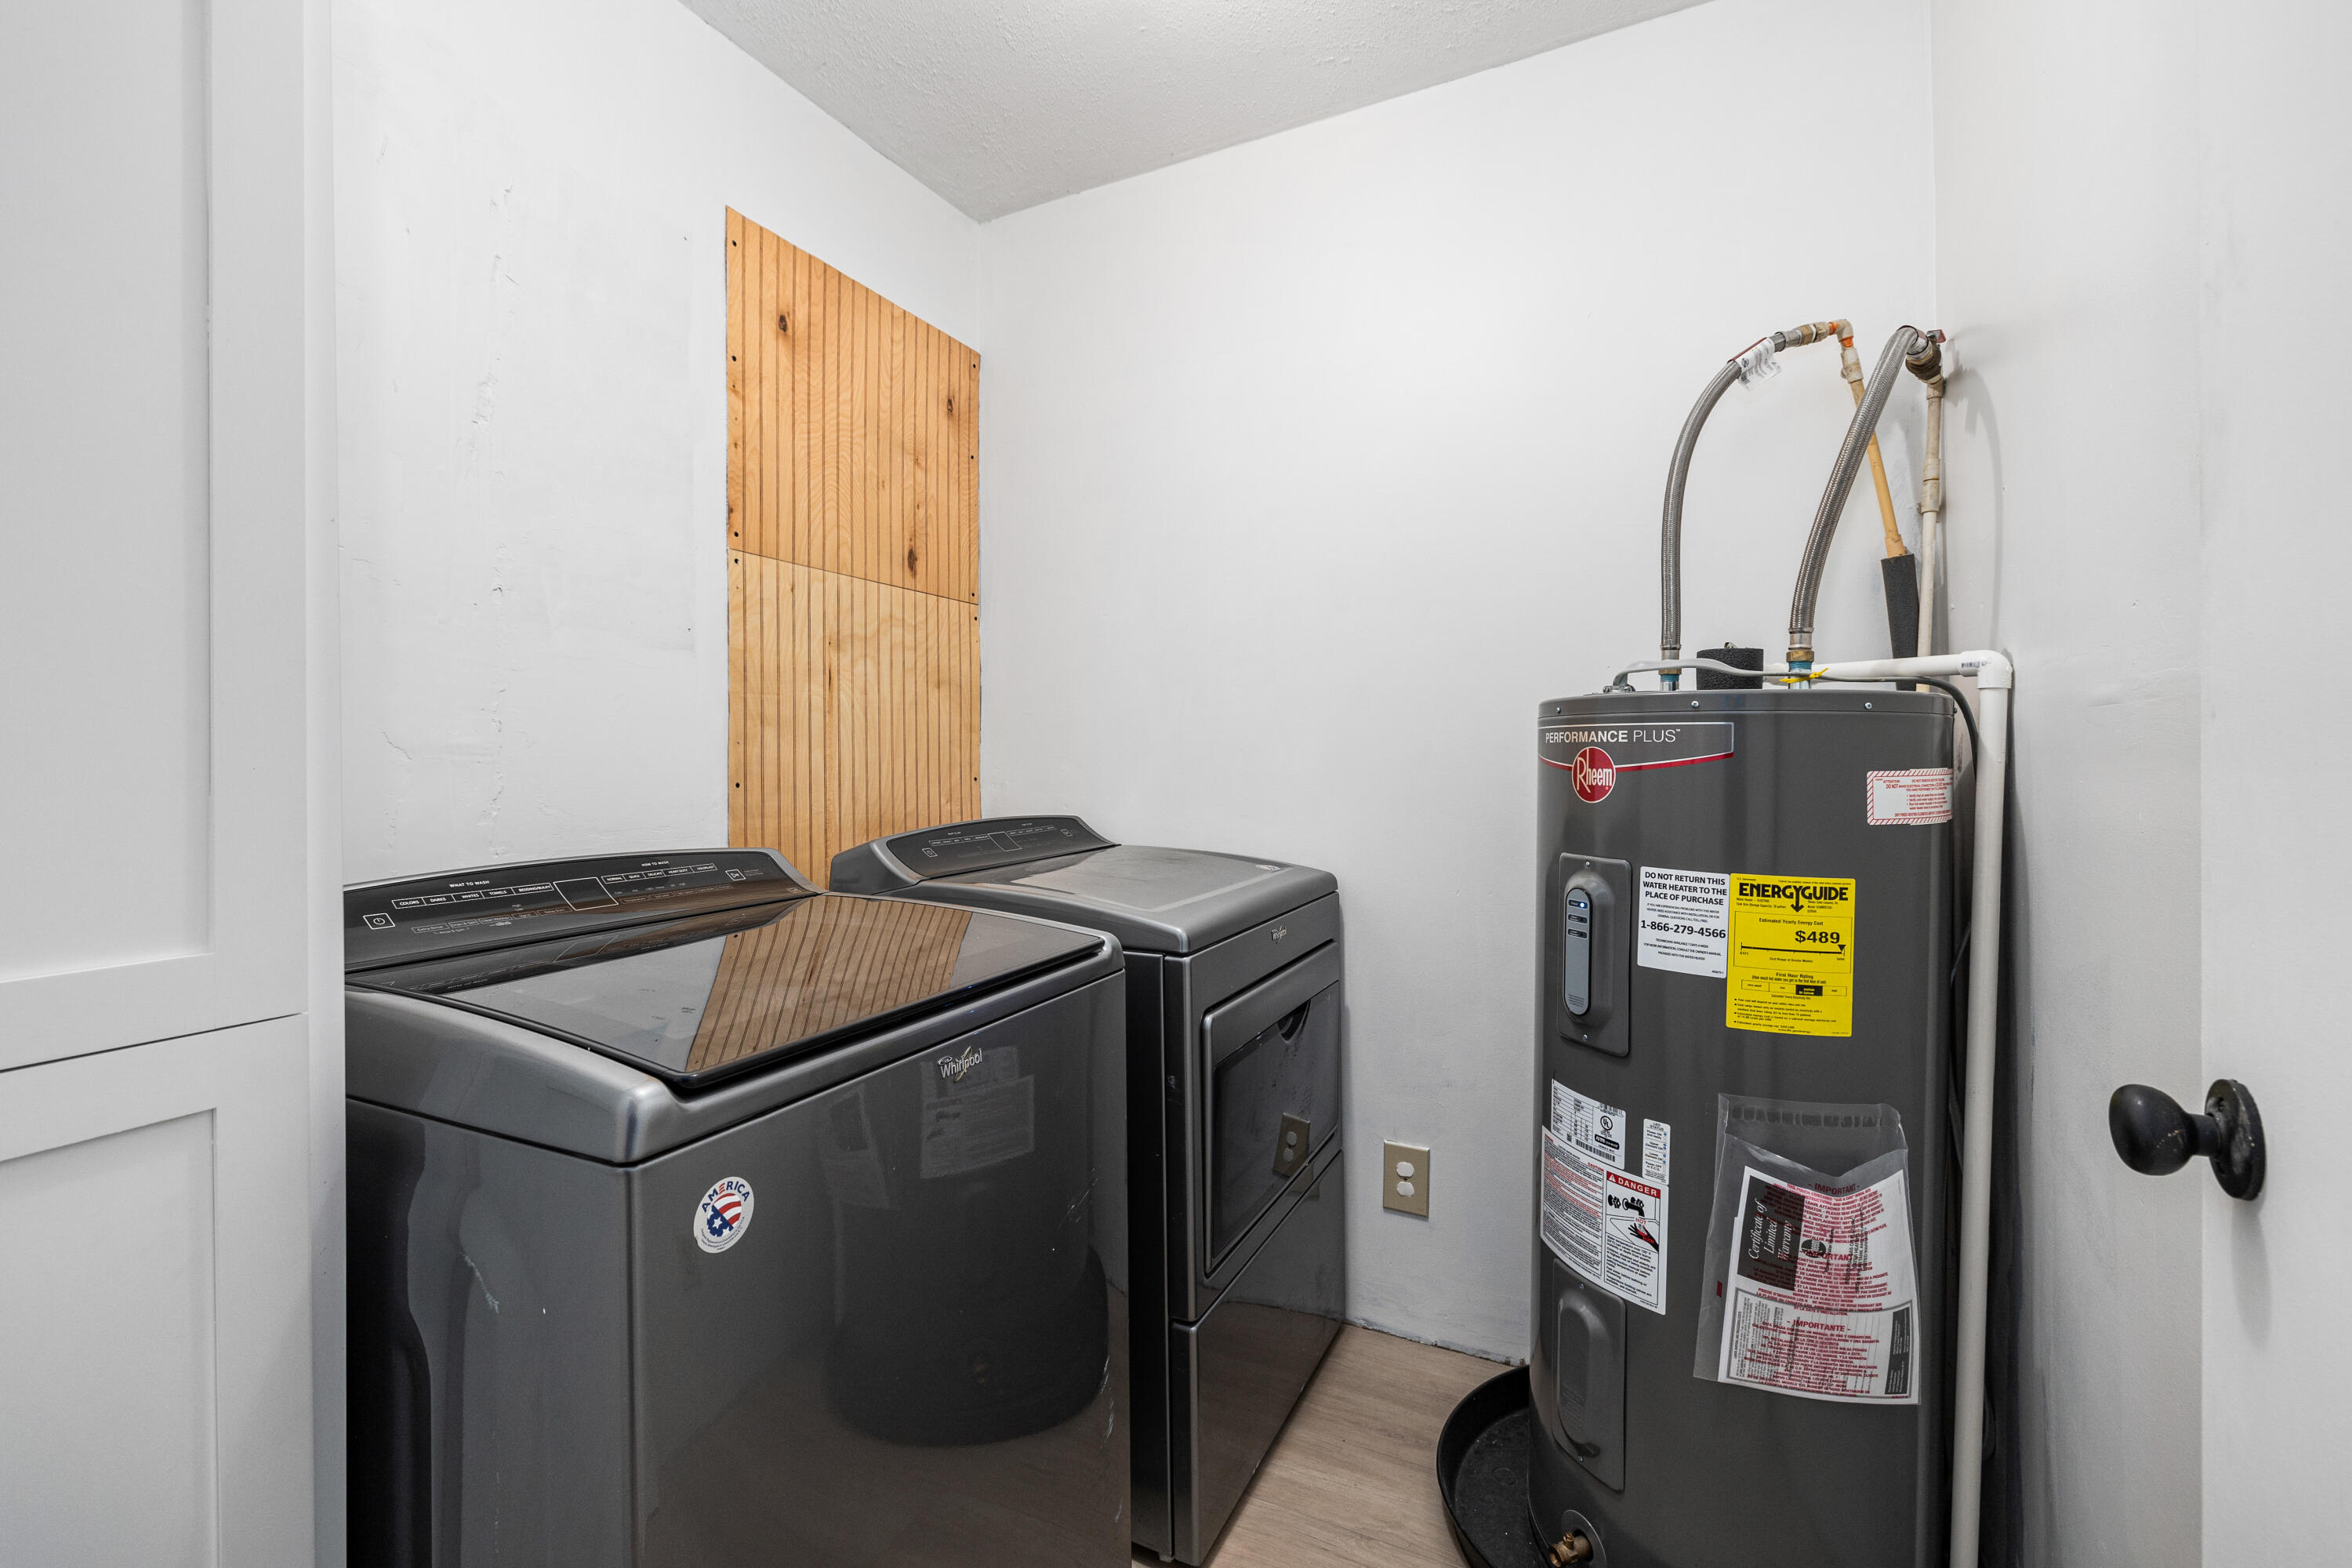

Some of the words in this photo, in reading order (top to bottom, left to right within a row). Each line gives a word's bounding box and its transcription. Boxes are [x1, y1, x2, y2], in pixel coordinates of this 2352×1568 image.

[1545, 730, 1628, 743] PERFORMANCE
[1577, 747, 1613, 793] Rheem
[1643, 881, 1667, 890] WATER
[1669, 884, 1697, 893] HEATER
[1675, 875, 1705, 884] RETURN
[1646, 891, 1668, 900] PLACE
[1682, 895, 1723, 906] PURCHASE
[1739, 883, 1849, 902] ENERGYGUIDE
[1641, 920, 1726, 938] 1-866-279-4566
[1795, 931, 1840, 944] $489
[941, 1047, 982, 1079] Whirlpool
[1588, 1162, 1604, 1172] CAUTION
[1618, 1178, 1657, 1196] DANGER
[1814, 1183, 1856, 1195] IMPORTANT
[702, 1181, 750, 1212] AMERICA
[1755, 1198, 1767, 1214] of
[1748, 1212, 1763, 1259] Certificate
[1764, 1217, 1777, 1254] Limited
[1777, 1220, 1795, 1261] Warranty
[1793, 1319, 1845, 1331] IMPORTANTE
